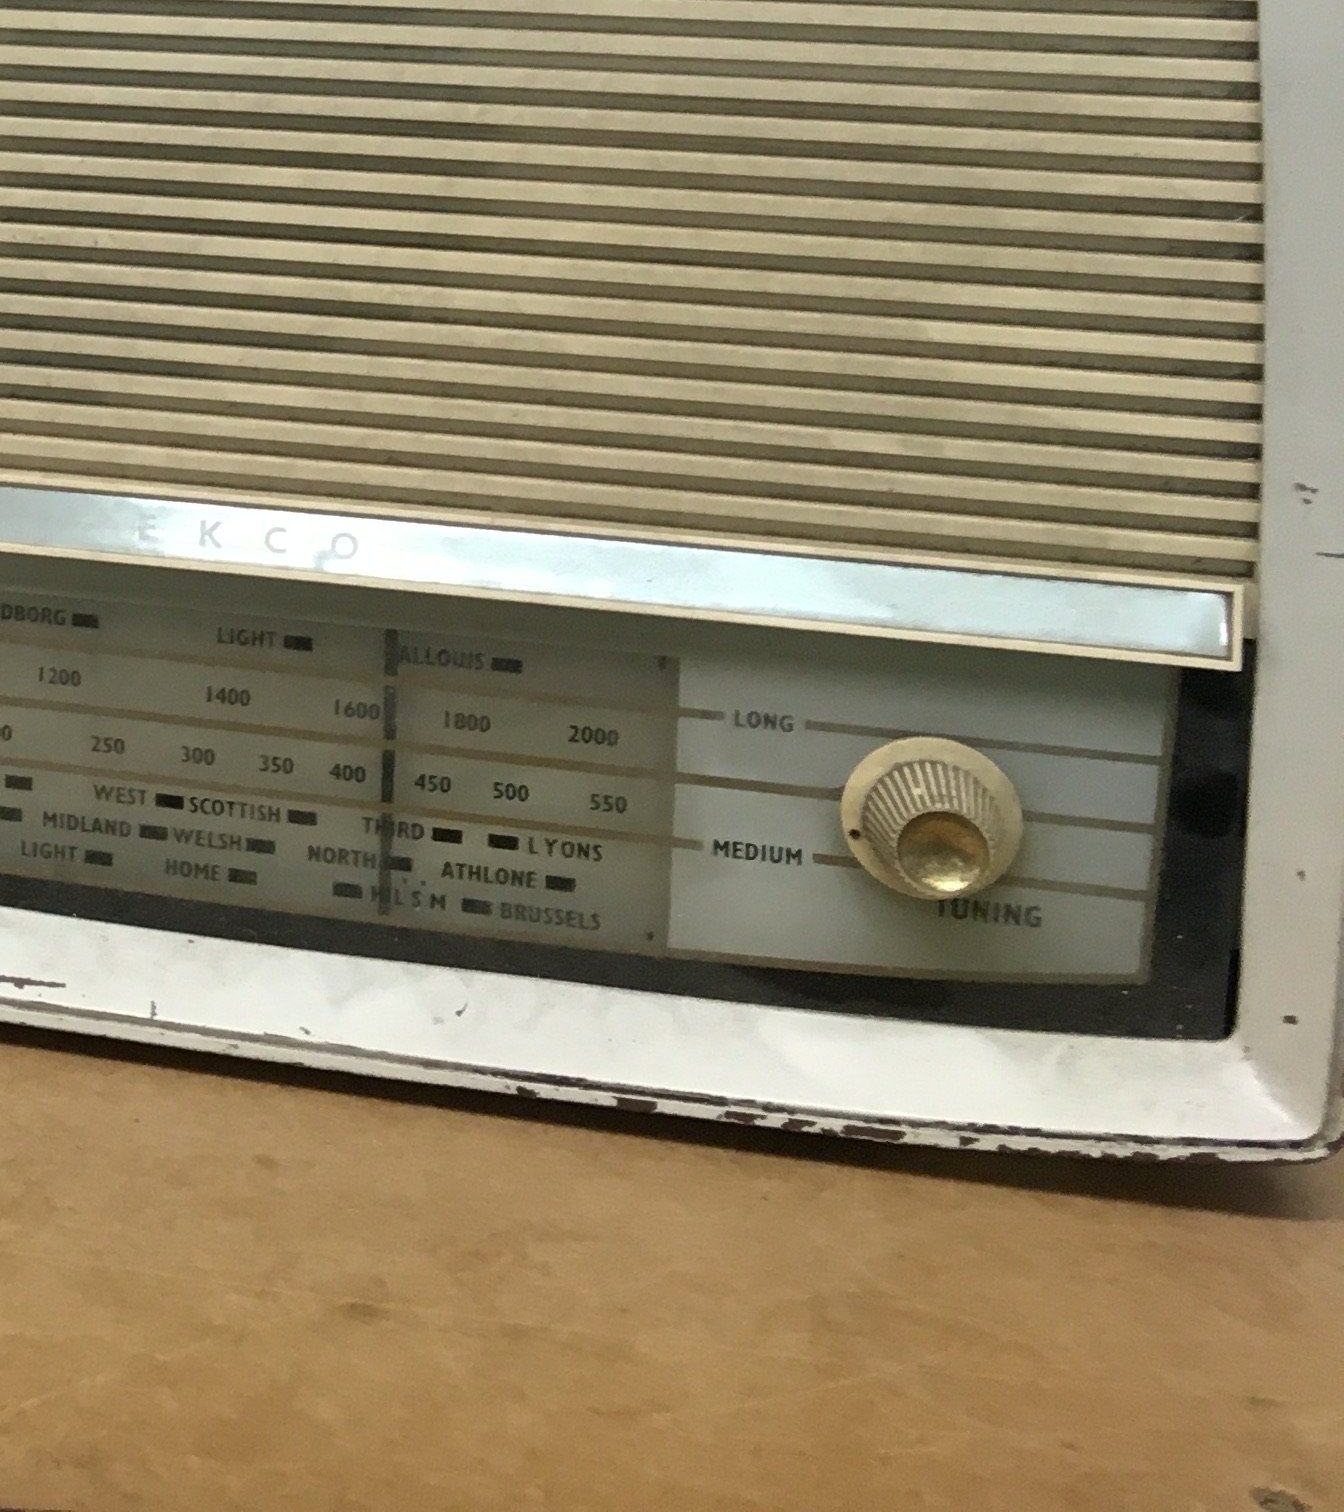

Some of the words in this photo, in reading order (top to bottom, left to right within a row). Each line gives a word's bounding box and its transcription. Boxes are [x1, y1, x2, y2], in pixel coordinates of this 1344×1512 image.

[137, 513, 359, 560] EKCO
[216, 626, 277, 648] LIGHT
[37, 666, 82, 687] 1200
[205, 685, 251, 706] 1400
[334, 699, 382, 720] 1600
[443, 710, 492, 733] 1800
[567, 724, 620, 747] 2000
[733, 709, 795, 734] LONG
[91, 735, 125, 755] 250
[181, 745, 216, 766] 300
[258, 754, 294, 775] 350
[329, 763, 367, 784] 400
[414, 773, 452, 794] 450
[493, 781, 530, 802] 500
[589, 793, 628, 814] 550
[42, 810, 132, 838] MIDLAND
[172, 826, 243, 851] WELSH
[307, 844, 377, 870] NORTH
[440, 861, 538, 889] ATHLONE
[92, 783, 149, 806] WEST
[188, 796, 282, 823] SCOTTISH
[527, 836, 604, 862] LYONS
[712, 838, 803, 867] MEDIUM
[20, 839, 79, 862] LIGHT
[164, 858, 221, 882] HOME
[499, 901, 602, 931] BRUSSELS
[936, 896, 1044, 929] TUNING
